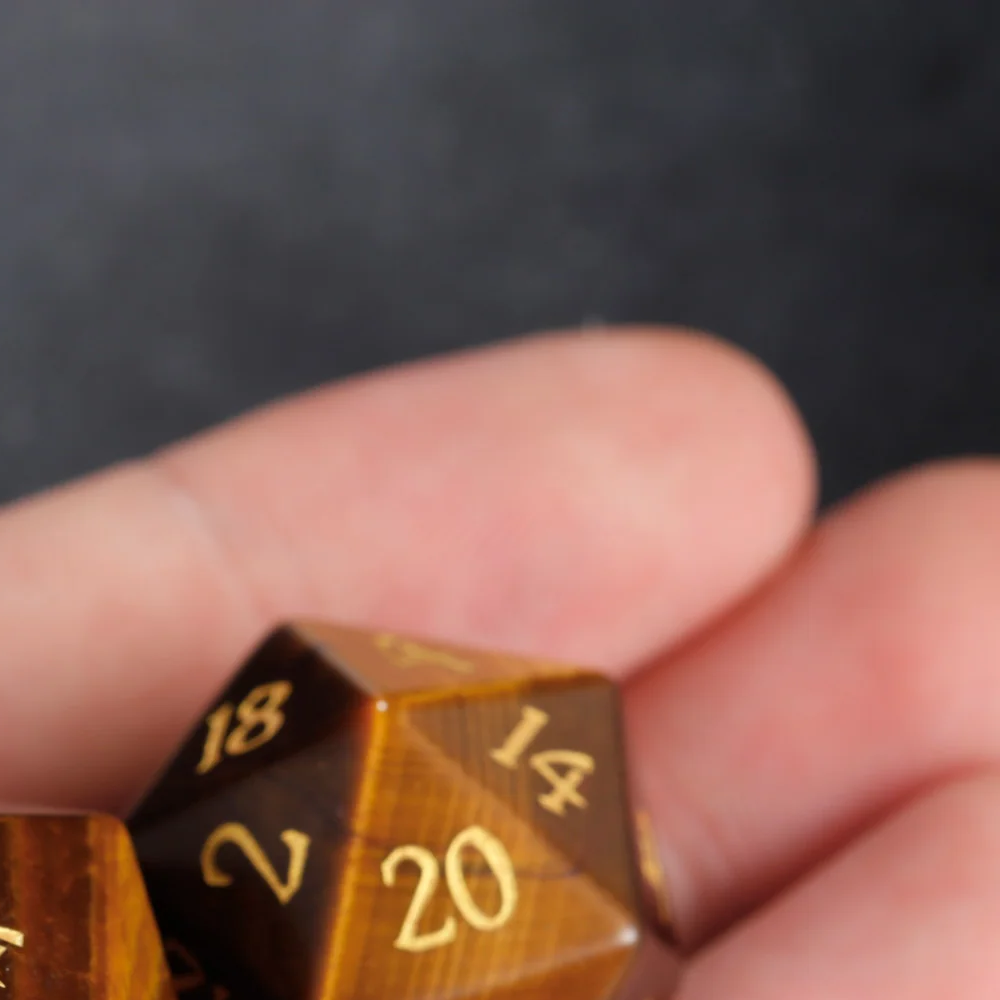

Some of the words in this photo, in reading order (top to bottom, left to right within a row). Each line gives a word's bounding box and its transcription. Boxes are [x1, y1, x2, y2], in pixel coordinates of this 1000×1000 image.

[196, 680, 292, 774] 18
[489, 705, 595, 815] 14
[201, 822, 311, 904] 2
[381, 825, 517, 952] 20
